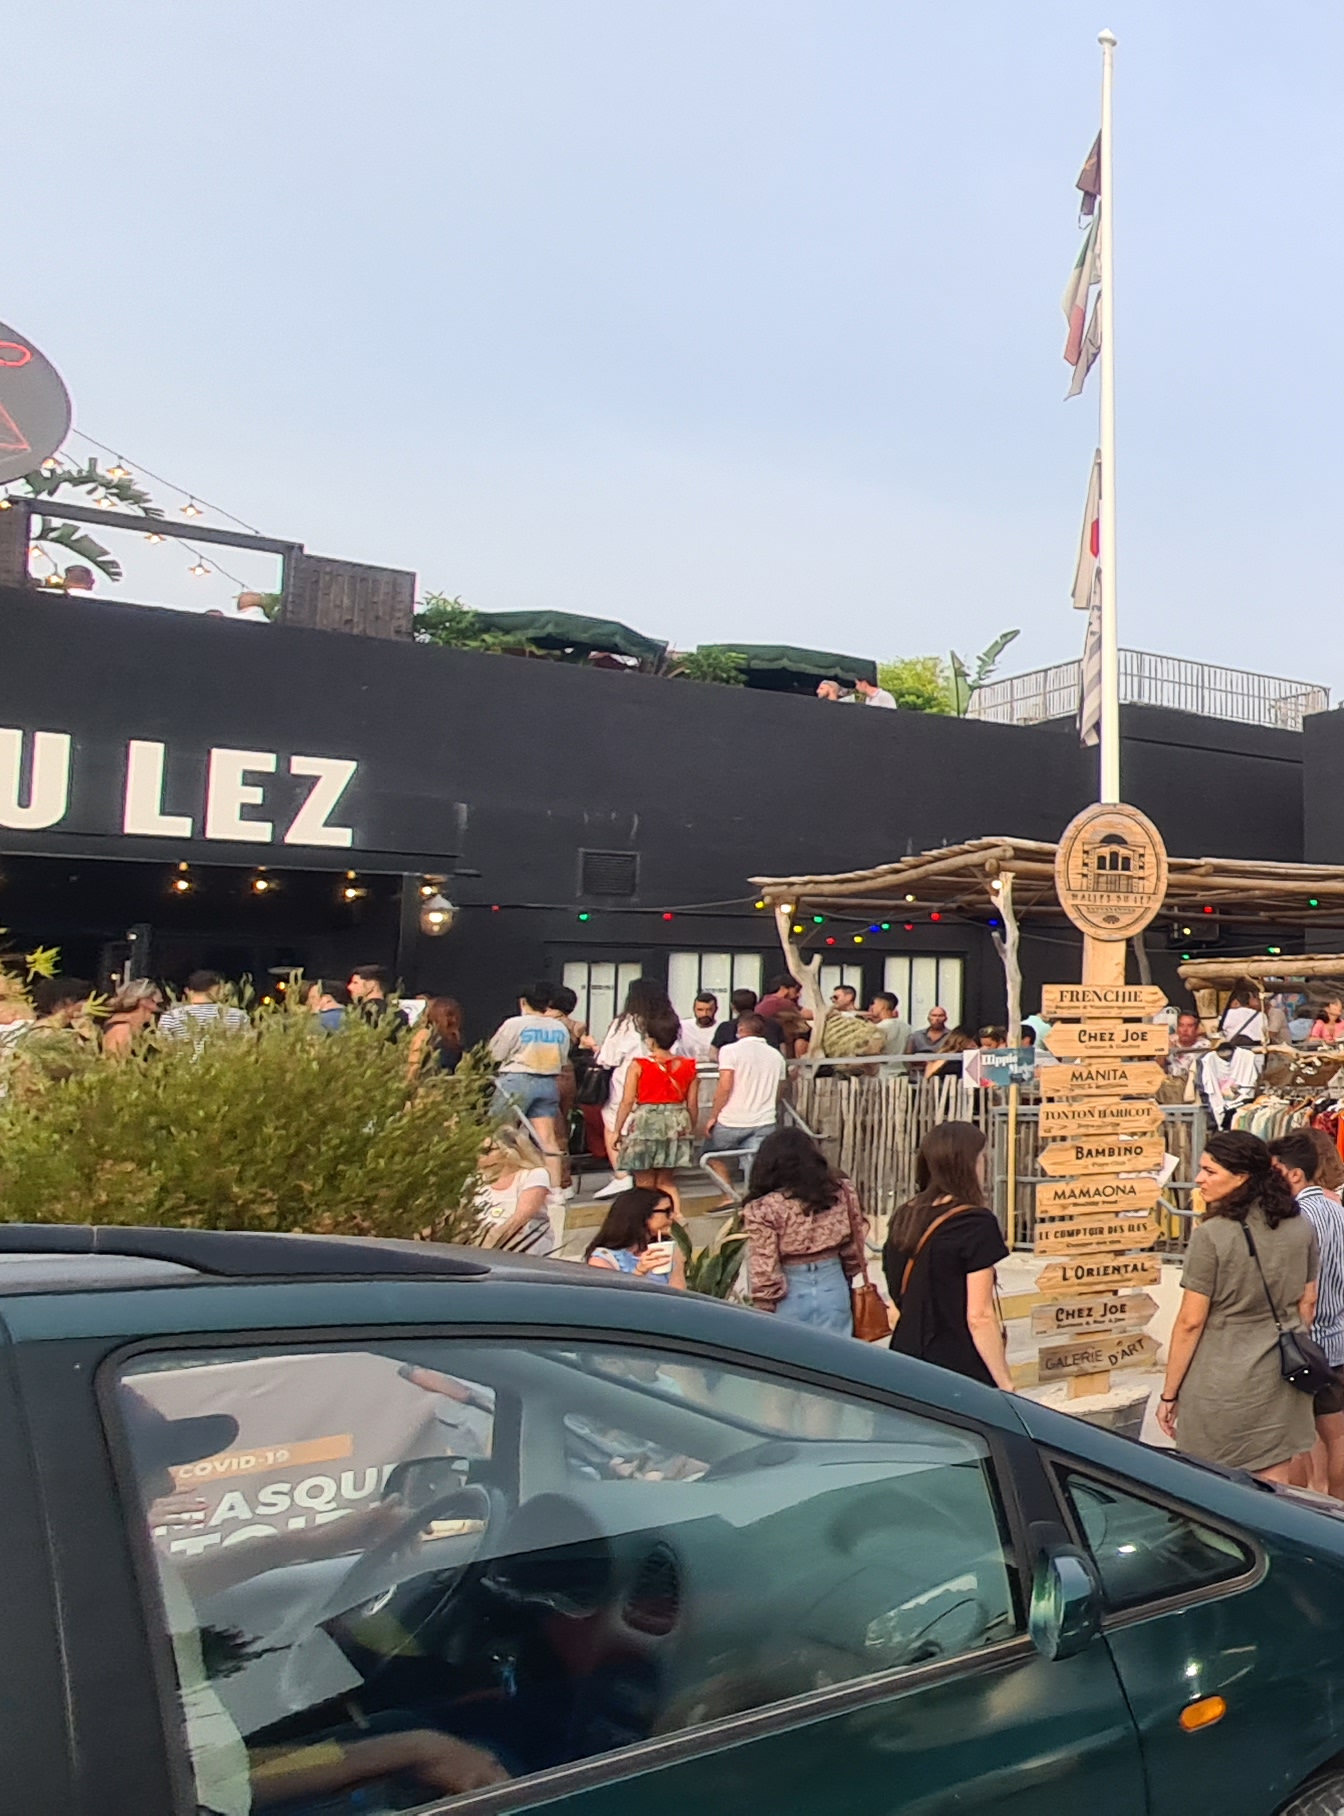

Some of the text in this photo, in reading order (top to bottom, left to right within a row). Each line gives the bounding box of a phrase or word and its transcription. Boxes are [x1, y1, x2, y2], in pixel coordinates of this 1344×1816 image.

[123, 740, 358, 847] LEZ
[1059, 989, 1143, 1003] FRENCHIE
[1077, 1029, 1148, 1044] CHEZ JOE
[1070, 1068, 1129, 1081] MANITA
[1043, 1107, 1153, 1121] TONTON HARICOT
[1075, 1146, 1144, 1160] BAMBINO
[1053, 1185, 1137, 1201] MAMAONA
[1038, 1231, 1050, 1240] LE
[1053, 1226, 1105, 1239] COMPTOIR
[1107, 1224, 1124, 1234] DES
[1055, 1302, 1128, 1322] CHEZ JOE
[1045, 1338, 1146, 1370] GALERIE D'ART
[178, 1450, 291, 1479] COVID-19
[154, 1463, 400, 1536] ASQU
